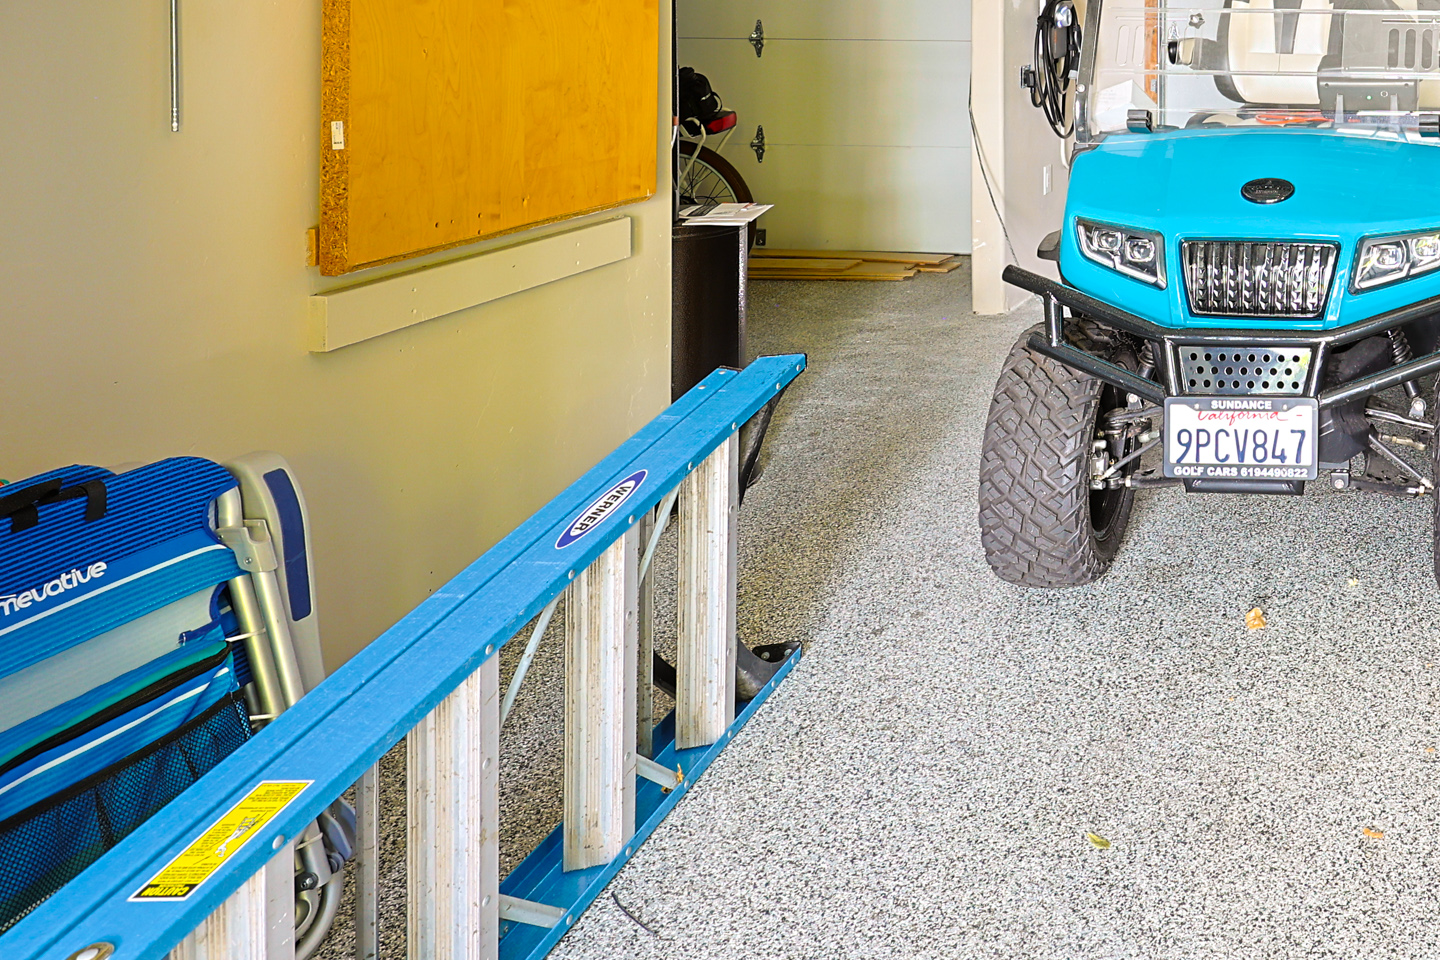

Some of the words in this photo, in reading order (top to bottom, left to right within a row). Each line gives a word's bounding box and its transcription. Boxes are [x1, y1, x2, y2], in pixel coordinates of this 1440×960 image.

[1210, 400, 1273, 410] SUNDANCE
[1176, 428, 1306, 464] 9PCV847
[1173, 466, 1204, 476] GOLF
[1206, 466, 1238, 477] CARS
[1240, 467, 1308, 478] 6194490822
[574, 486, 632, 531] WERNER
[140, 886, 190, 897] CAUTION
